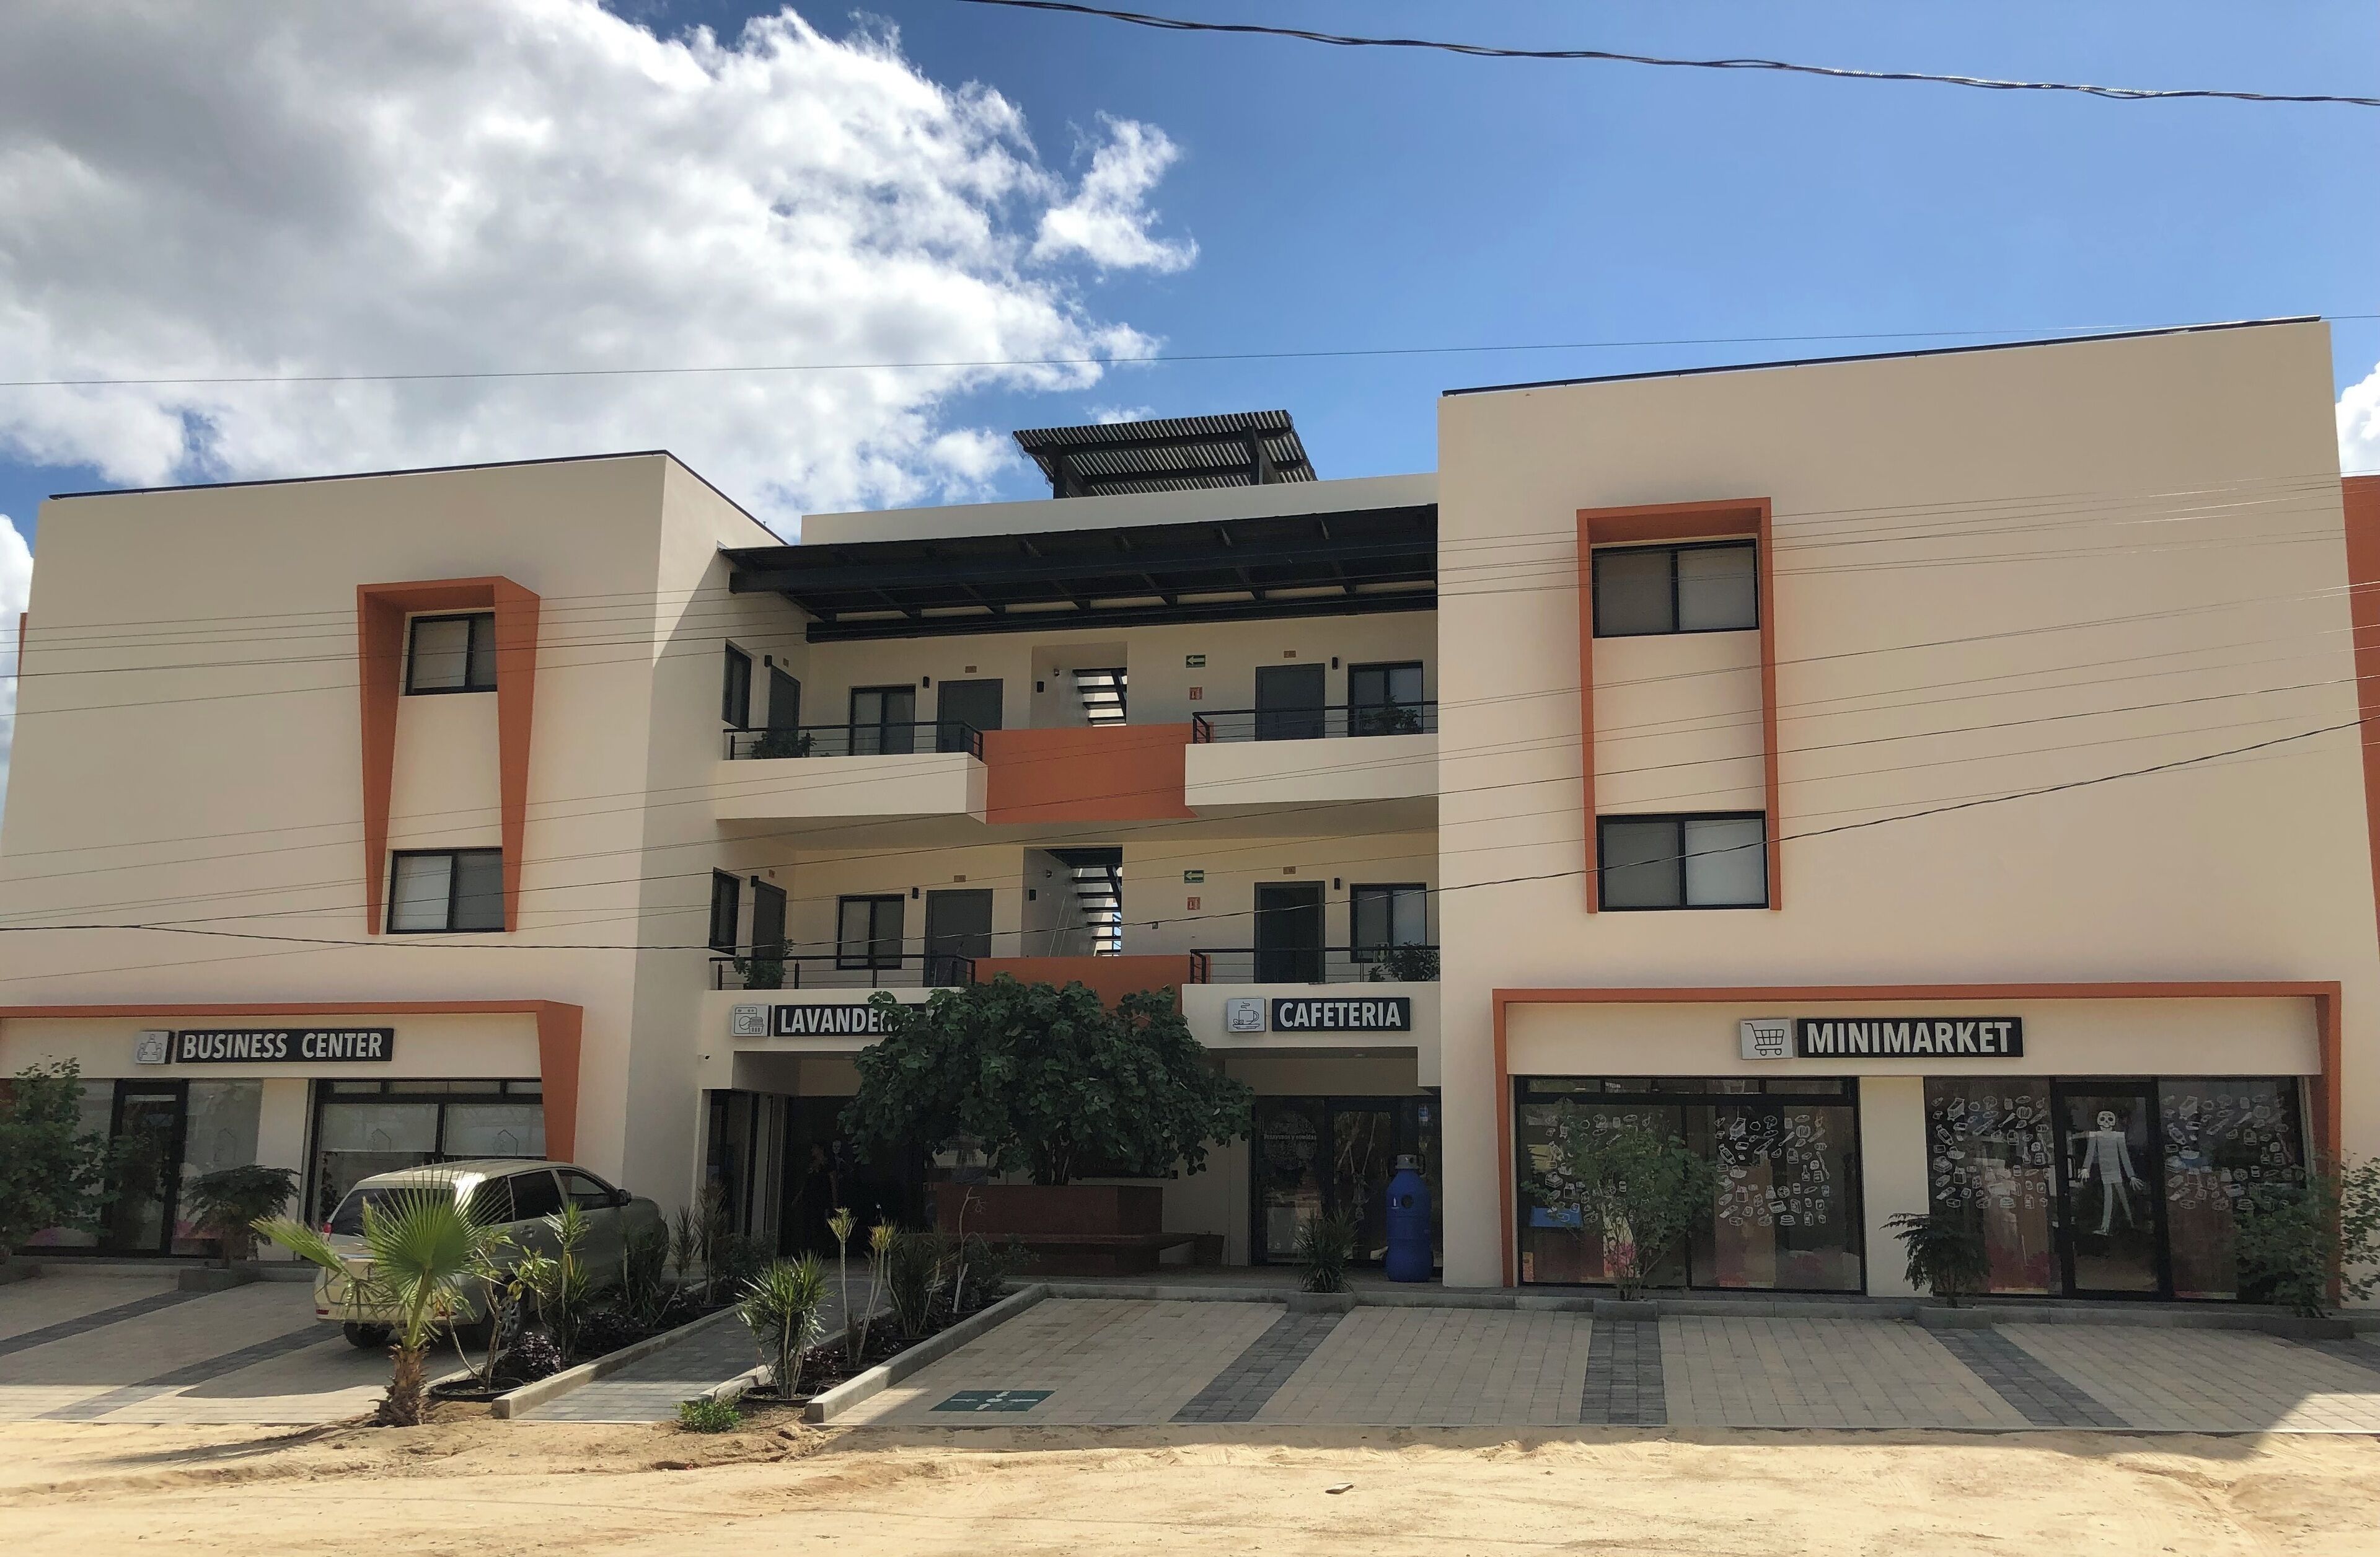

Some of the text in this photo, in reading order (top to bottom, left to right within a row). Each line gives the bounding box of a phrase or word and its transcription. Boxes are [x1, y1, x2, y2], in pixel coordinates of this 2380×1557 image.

[780, 1007, 900, 1033] LAVANDE
[1279, 1002, 1401, 1028] CAFETERIA
[182, 1033, 382, 1059] BUSINESS CENTER
[1807, 1021, 2012, 1053] MINIMARKET
